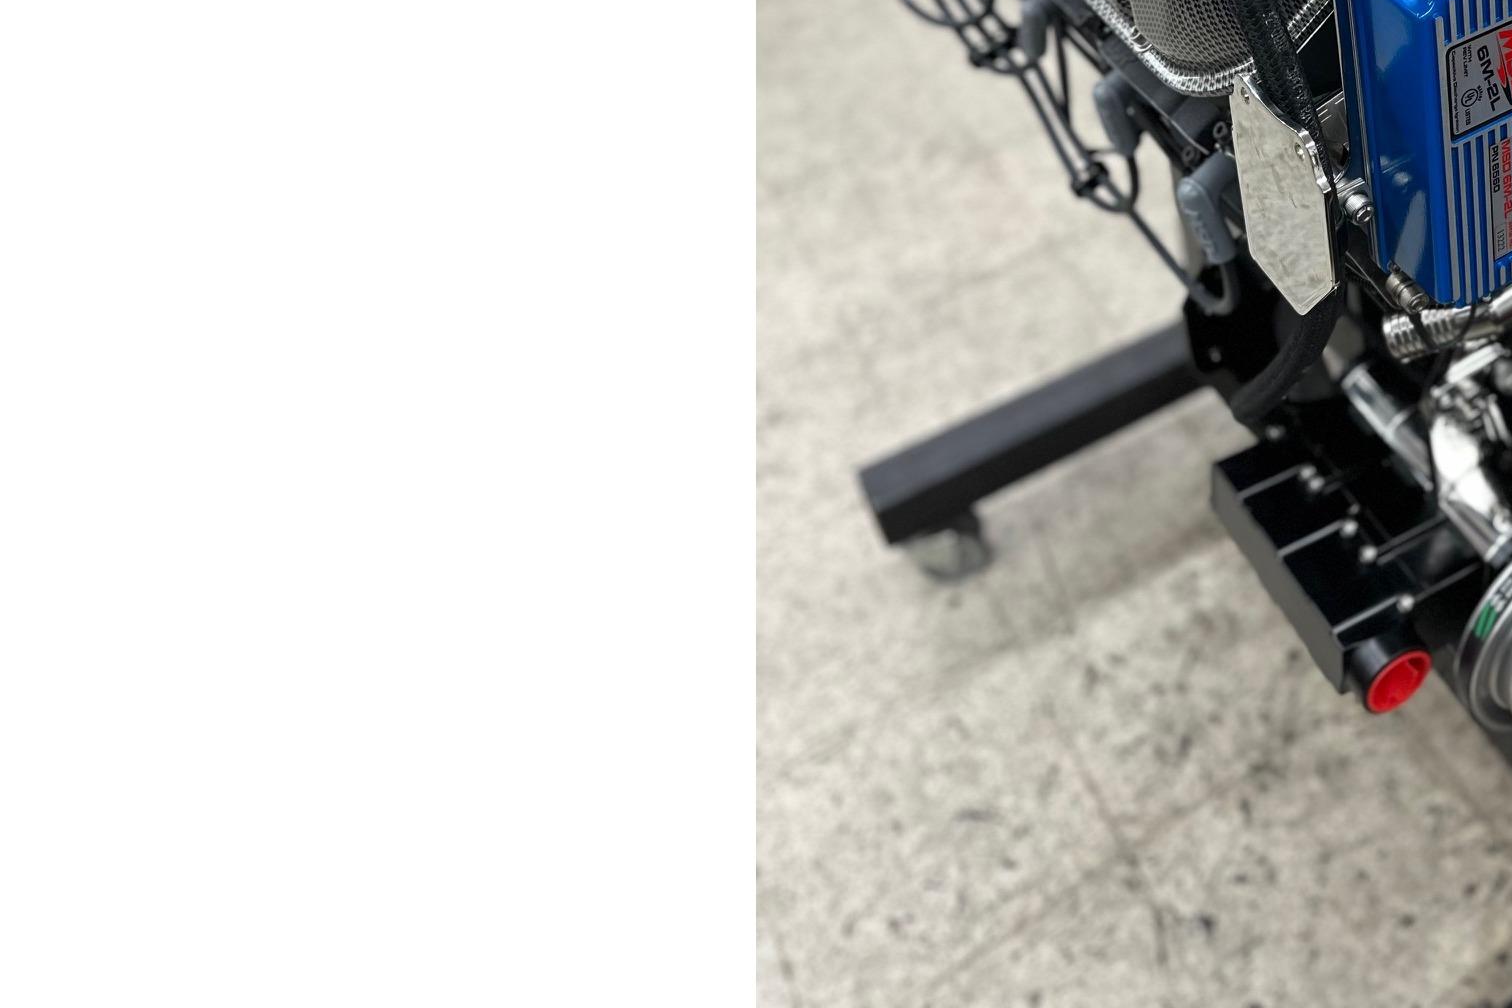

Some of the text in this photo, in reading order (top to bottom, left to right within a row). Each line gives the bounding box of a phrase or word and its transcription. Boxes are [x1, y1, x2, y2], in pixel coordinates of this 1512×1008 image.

[1477, 45, 1501, 112] 6M-2L
[1492, 145, 1499, 162] PN
[1502, 139, 1511, 173] MSD
[1503, 174, 1512, 219] 6M-2L
